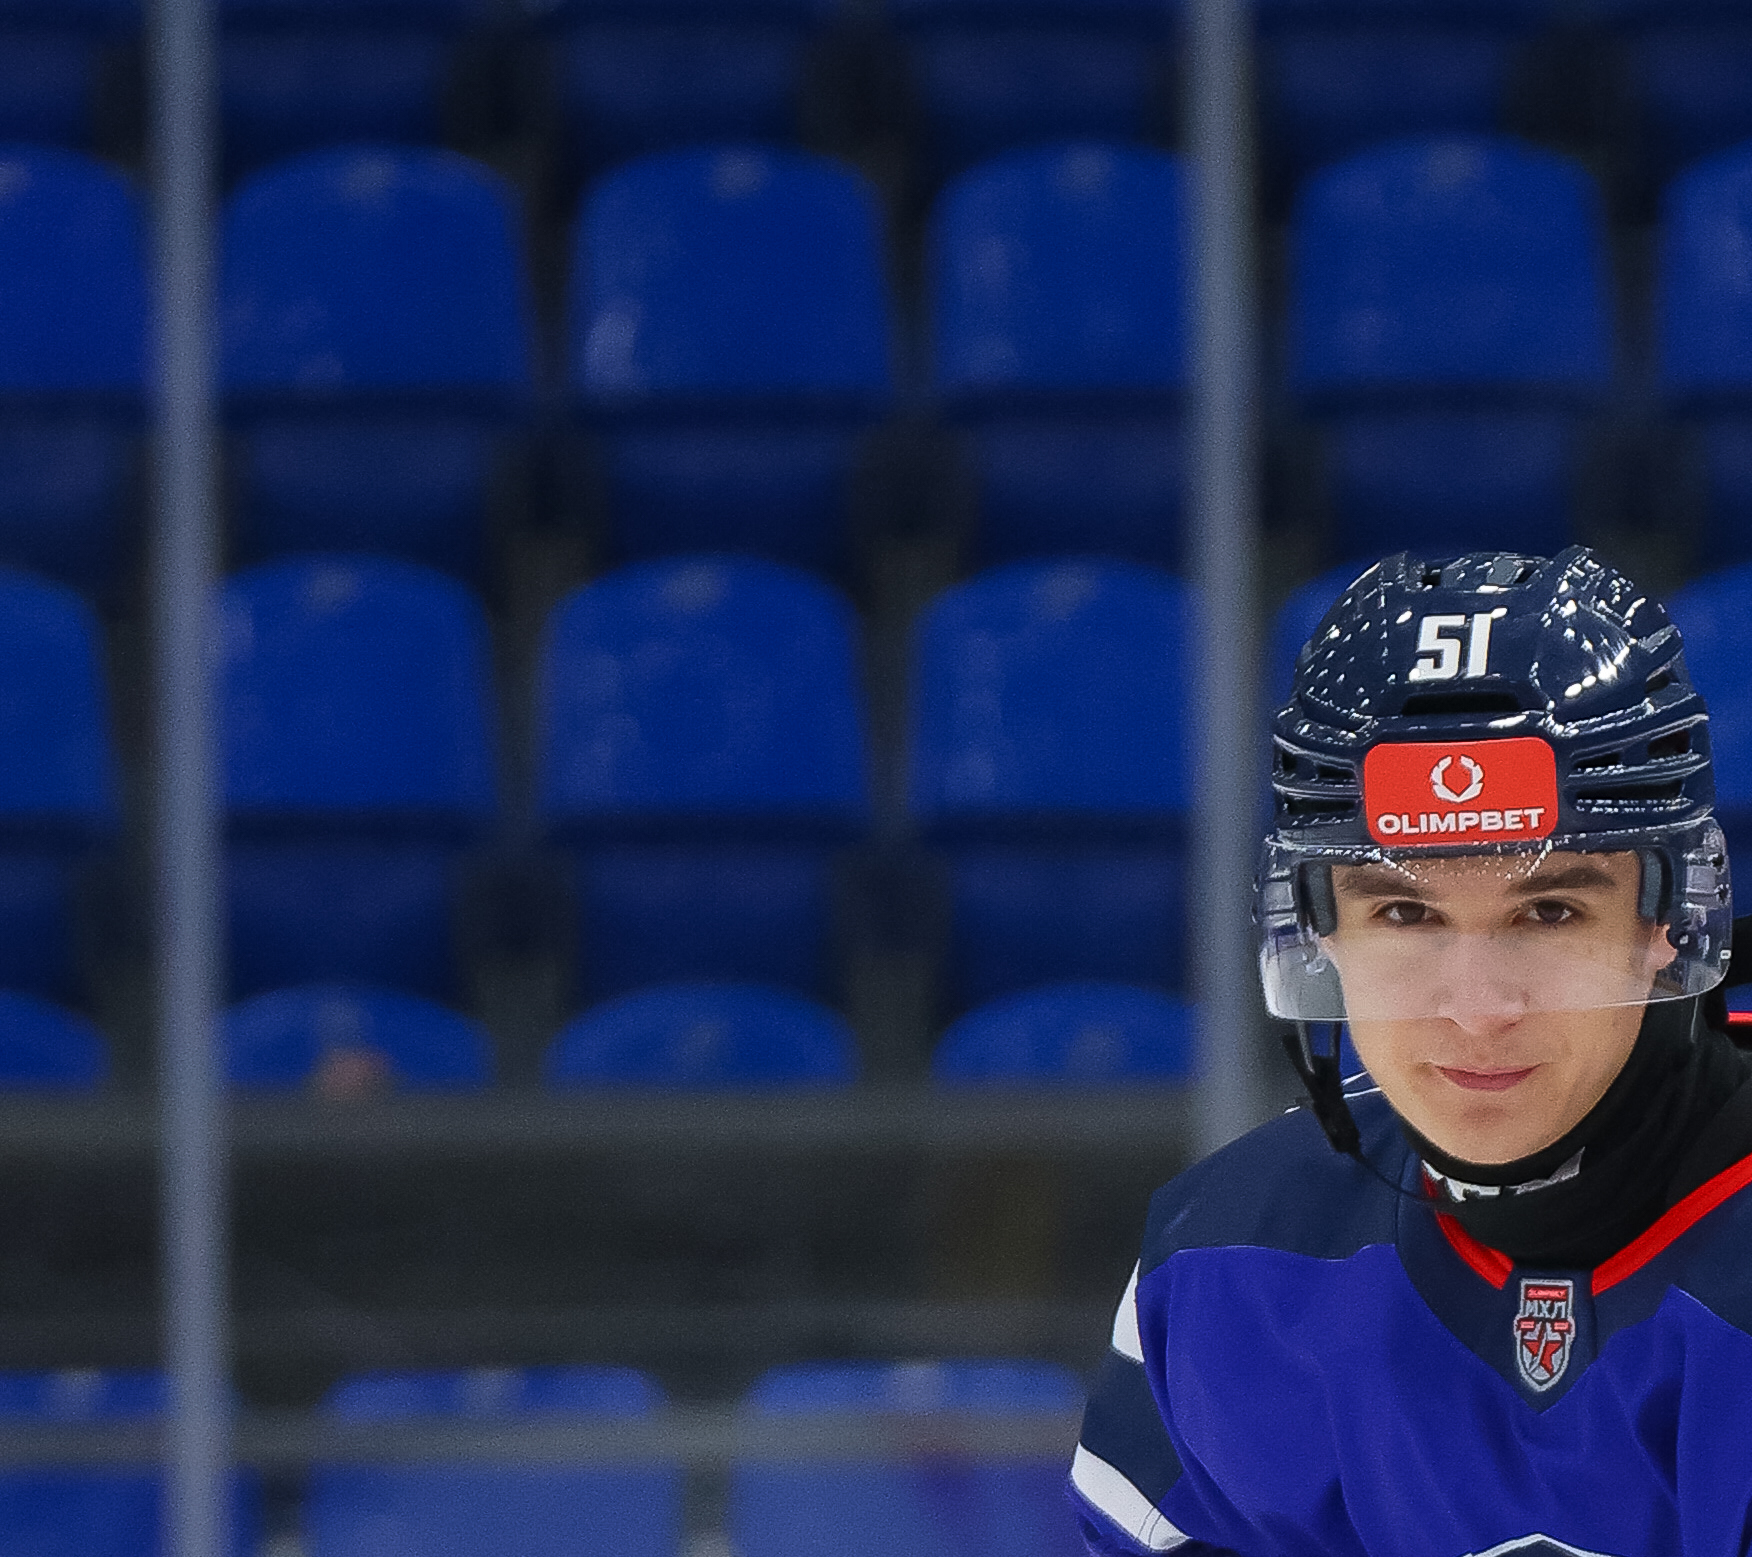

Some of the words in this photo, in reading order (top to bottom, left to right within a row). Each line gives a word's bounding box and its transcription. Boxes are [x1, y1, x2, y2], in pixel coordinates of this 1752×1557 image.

[1411, 612, 1494, 681] 51
[1376, 806, 1546, 834] OLIMPBET
[1525, 1299, 1568, 1319] МХЛ
